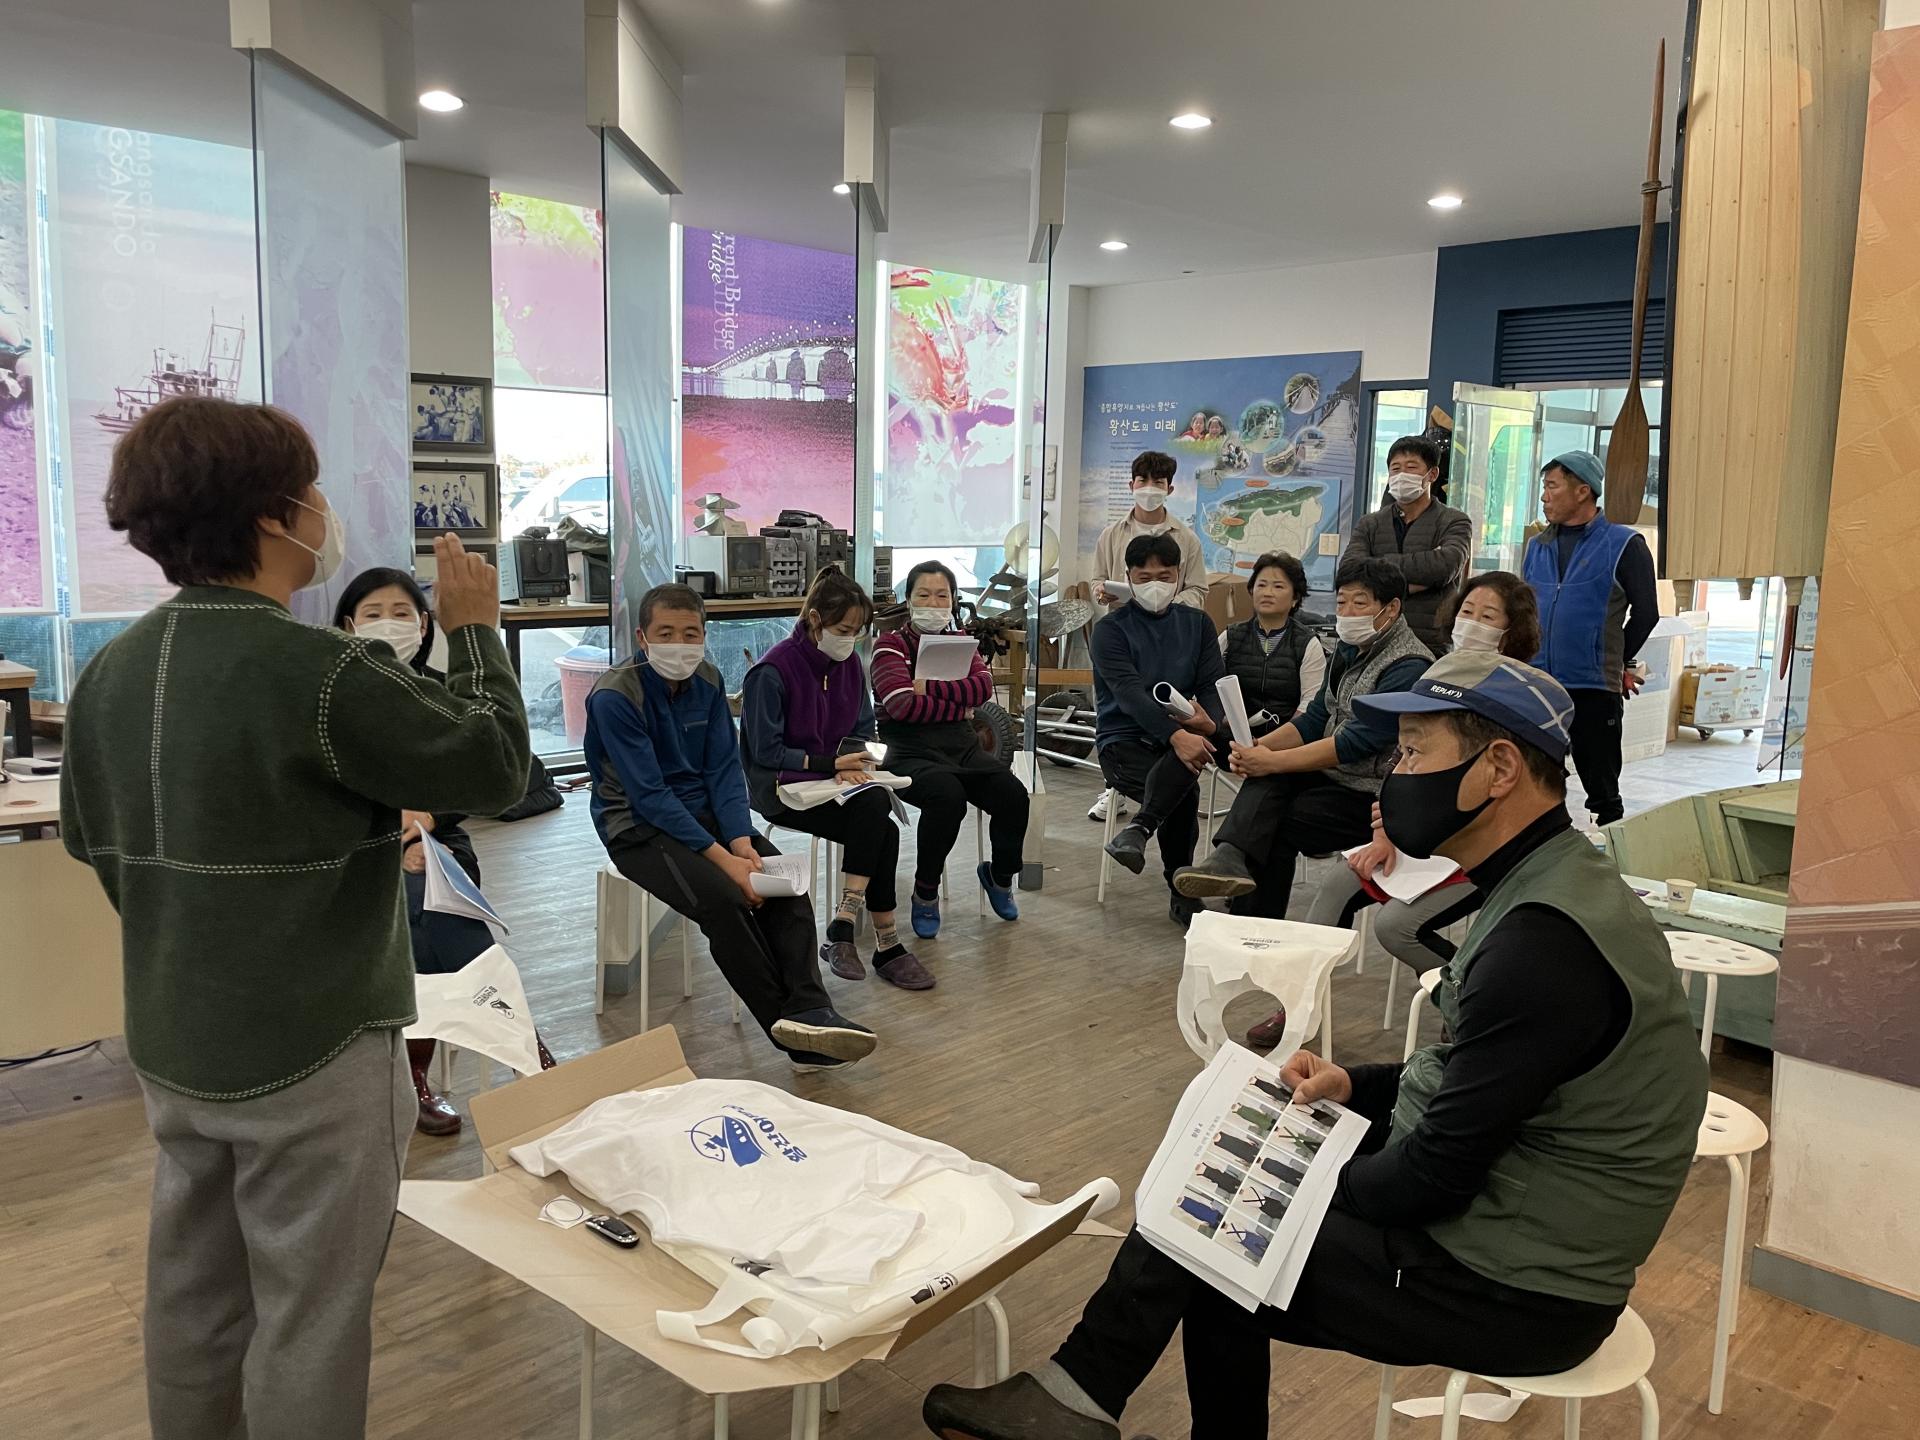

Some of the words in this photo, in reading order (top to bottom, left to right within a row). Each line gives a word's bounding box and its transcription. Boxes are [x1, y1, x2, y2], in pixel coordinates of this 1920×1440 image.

[110, 127, 137, 257] GSANDO
[708, 231, 726, 284] ridge
[725, 233, 739, 279] rend
[722, 287, 741, 350] Bridge
[1154, 418, 1177, 432] 미래
[1431, 685, 1457, 696] REPLAY
